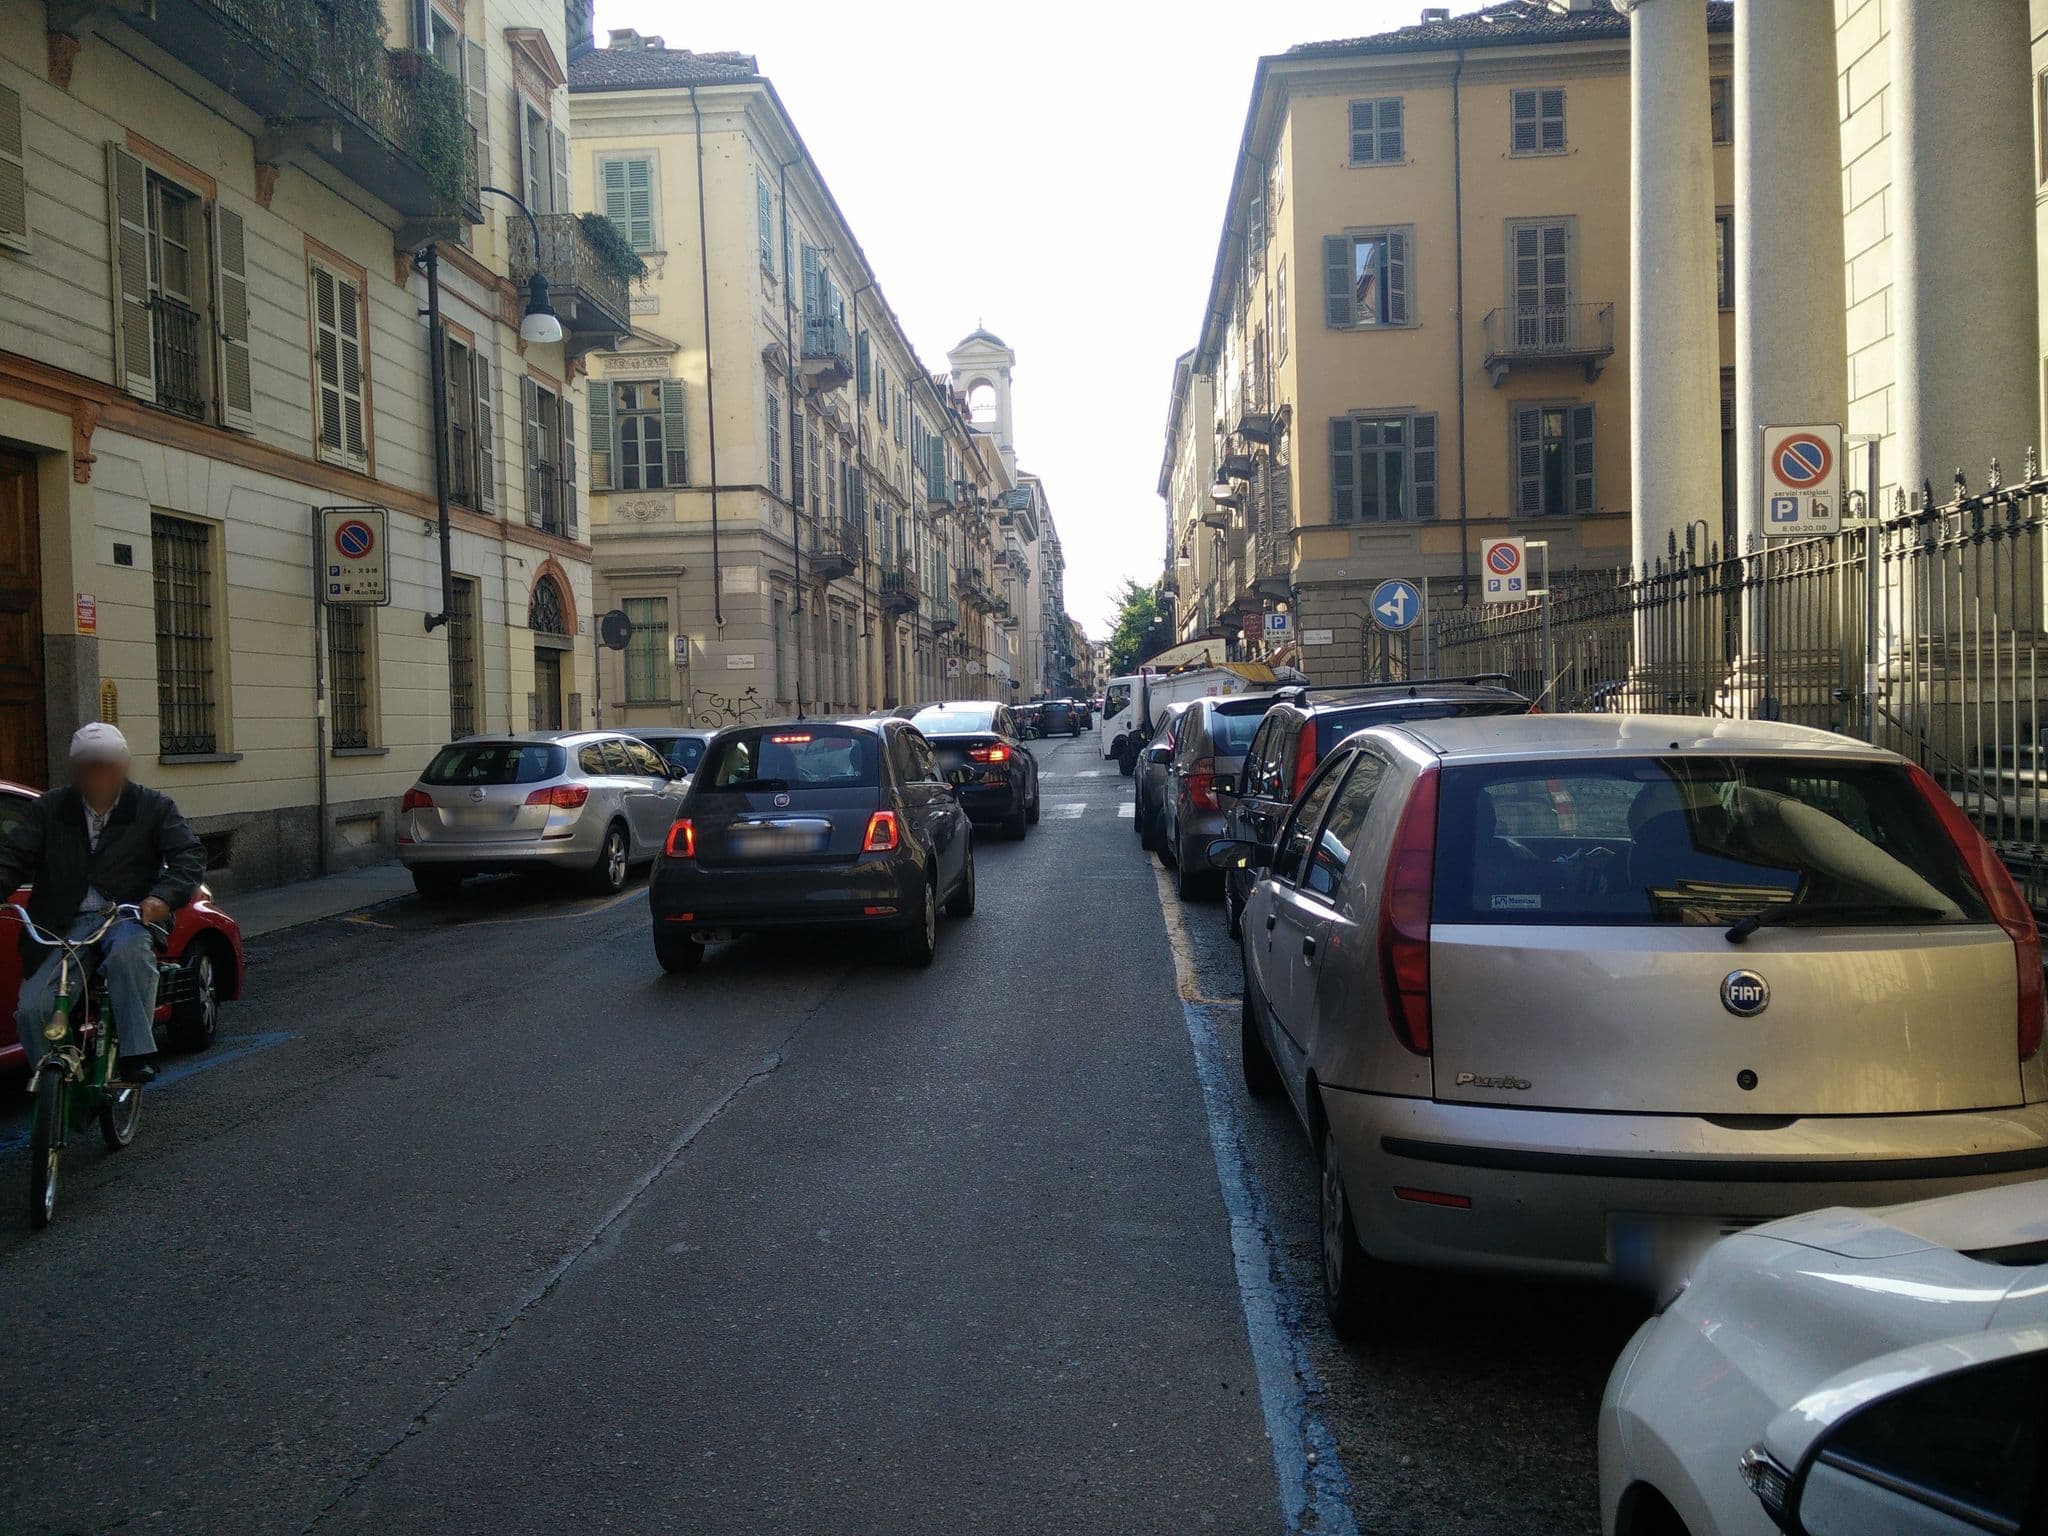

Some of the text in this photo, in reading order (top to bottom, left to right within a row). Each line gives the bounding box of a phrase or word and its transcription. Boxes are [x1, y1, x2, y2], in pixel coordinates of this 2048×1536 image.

[1800, 489, 1829, 498] religiosi
[1777, 500, 1794, 519] P
[1490, 581, 1499, 591] P
[1274, 616, 1284, 629] P
[1730, 985, 1762, 1001] FIAT
[1455, 1071, 1533, 1091] Punto
